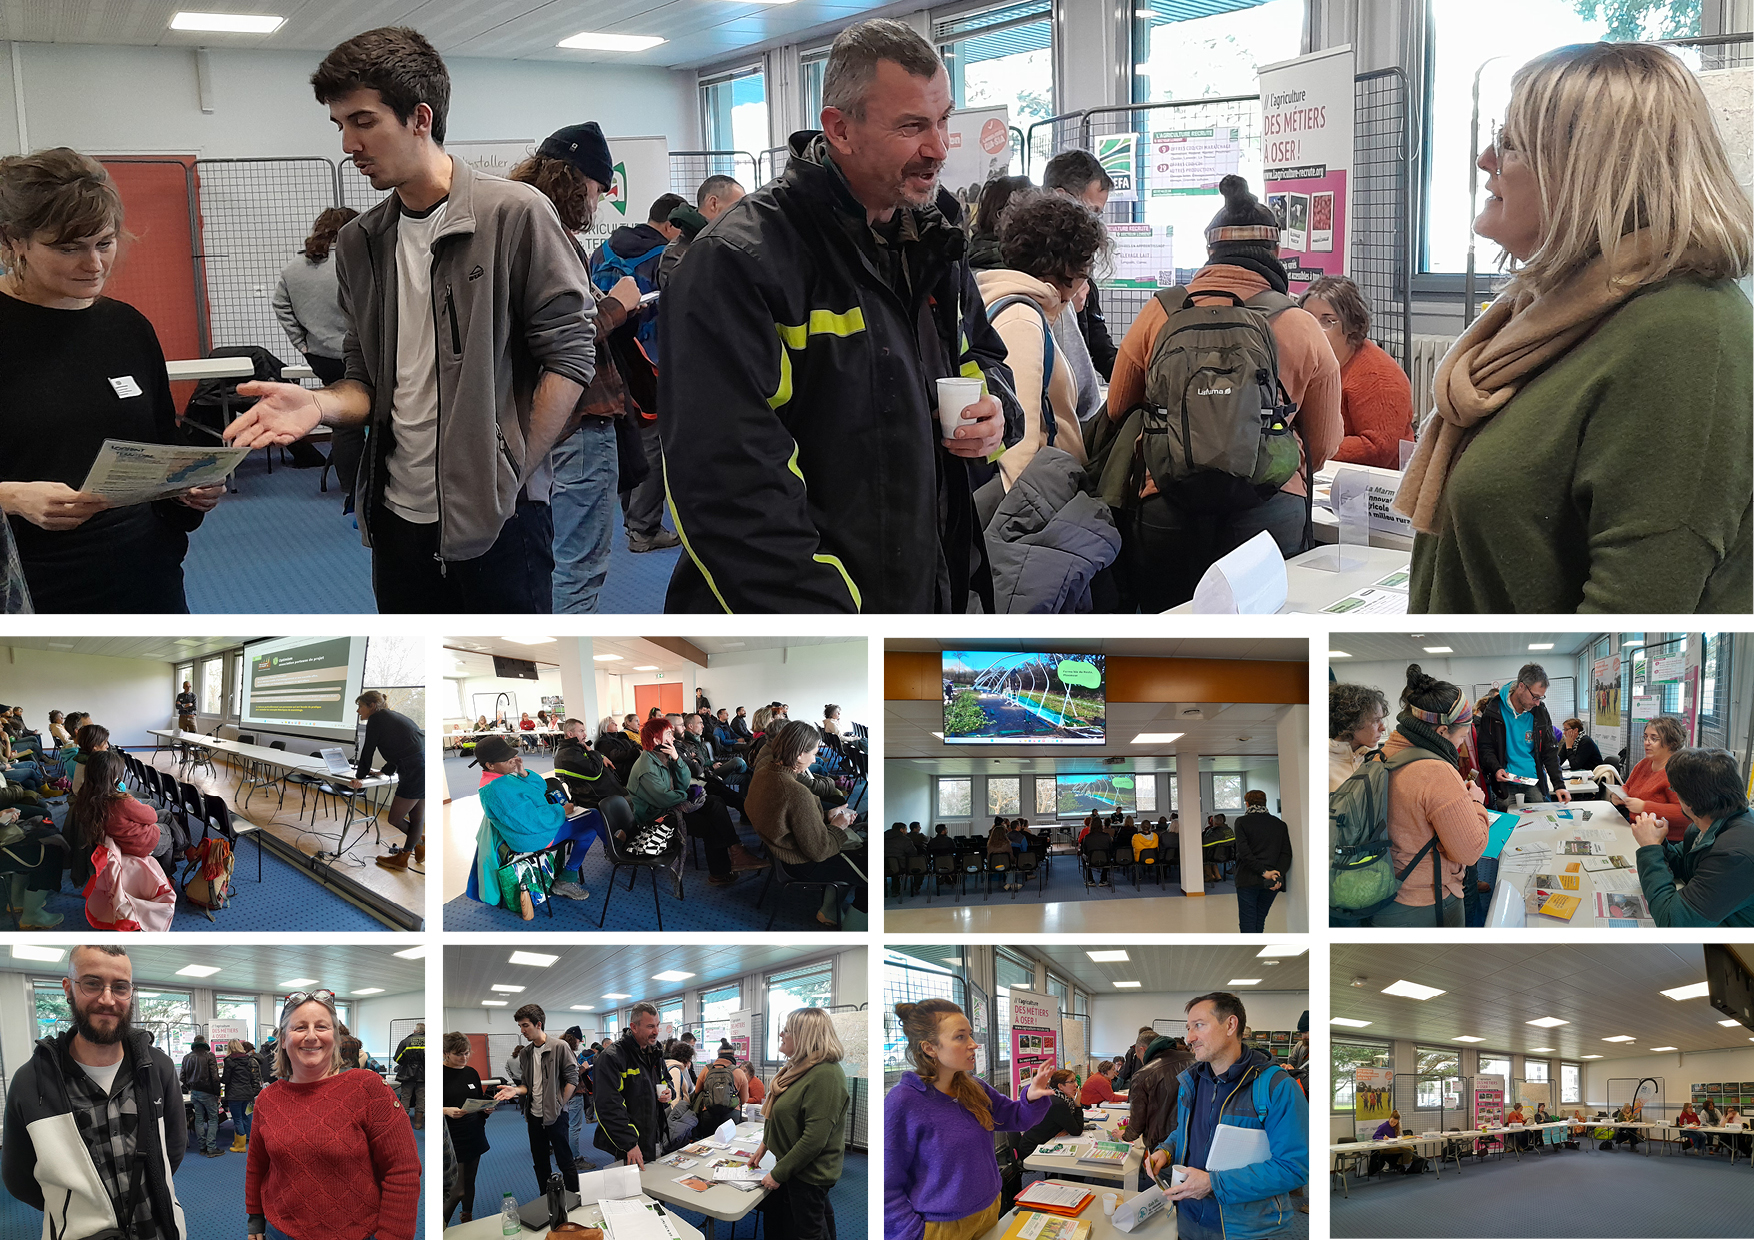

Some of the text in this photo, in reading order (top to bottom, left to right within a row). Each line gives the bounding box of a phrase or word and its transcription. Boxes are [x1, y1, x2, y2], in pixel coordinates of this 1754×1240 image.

[1271, 90, 1306, 109] l'agriculture
[1264, 106, 1326, 136] DES MÉTIERS
[1271, 140, 1295, 162] OSER
[1197, 388, 1223, 396] Lafuma
[1373, 511, 1395, 521] milieu
[1015, 1005, 1049, 1017] DES MÉTIERS
[1020, 1016, 1034, 1025] OSER
